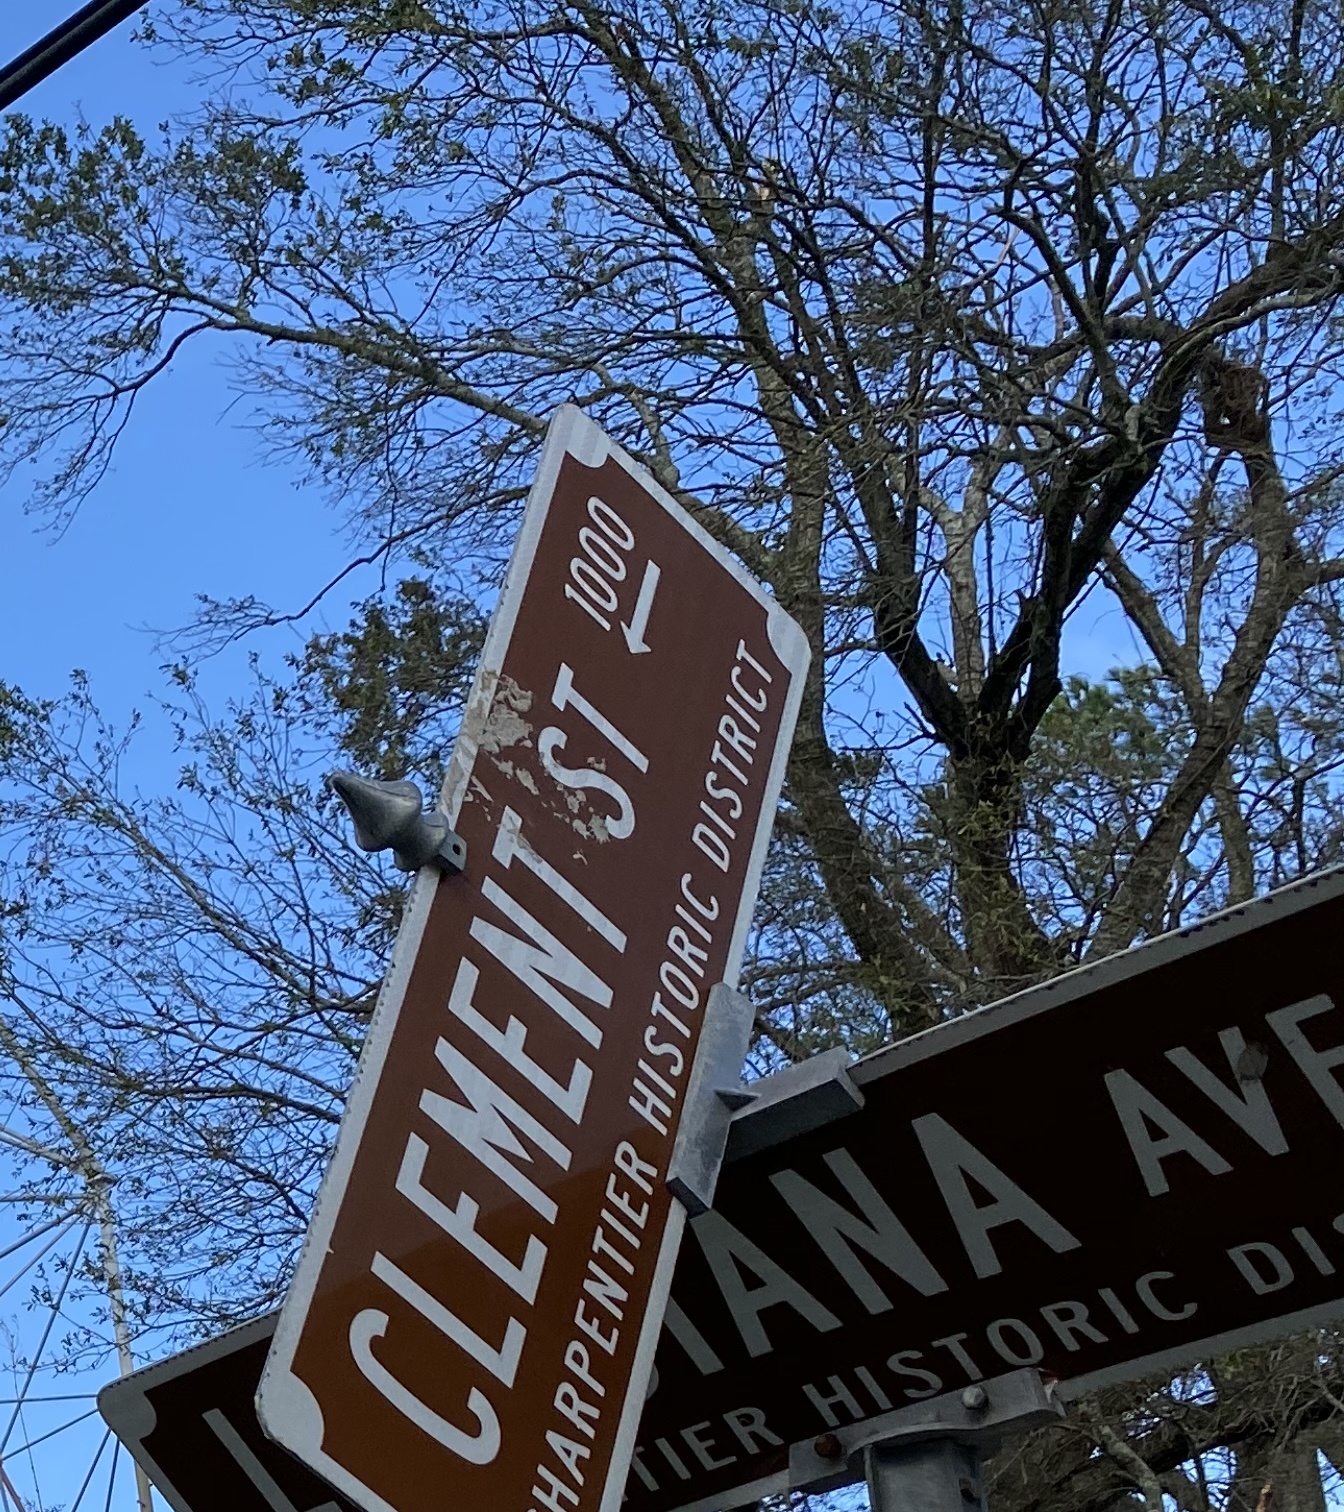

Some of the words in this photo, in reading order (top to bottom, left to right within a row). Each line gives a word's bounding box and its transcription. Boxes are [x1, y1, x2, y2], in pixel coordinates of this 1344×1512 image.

[564, 496, 635, 631] 1000
[348, 804, 628, 1465] CLEMENT
[537, 662, 650, 840] ST
[628, 873, 719, 1136] HISTORIC
[692, 638, 773, 873] DISTRICT
[801, 1271, 1198, 1428] HISTORIC
[1226, 1211, 1344, 1296] DI
